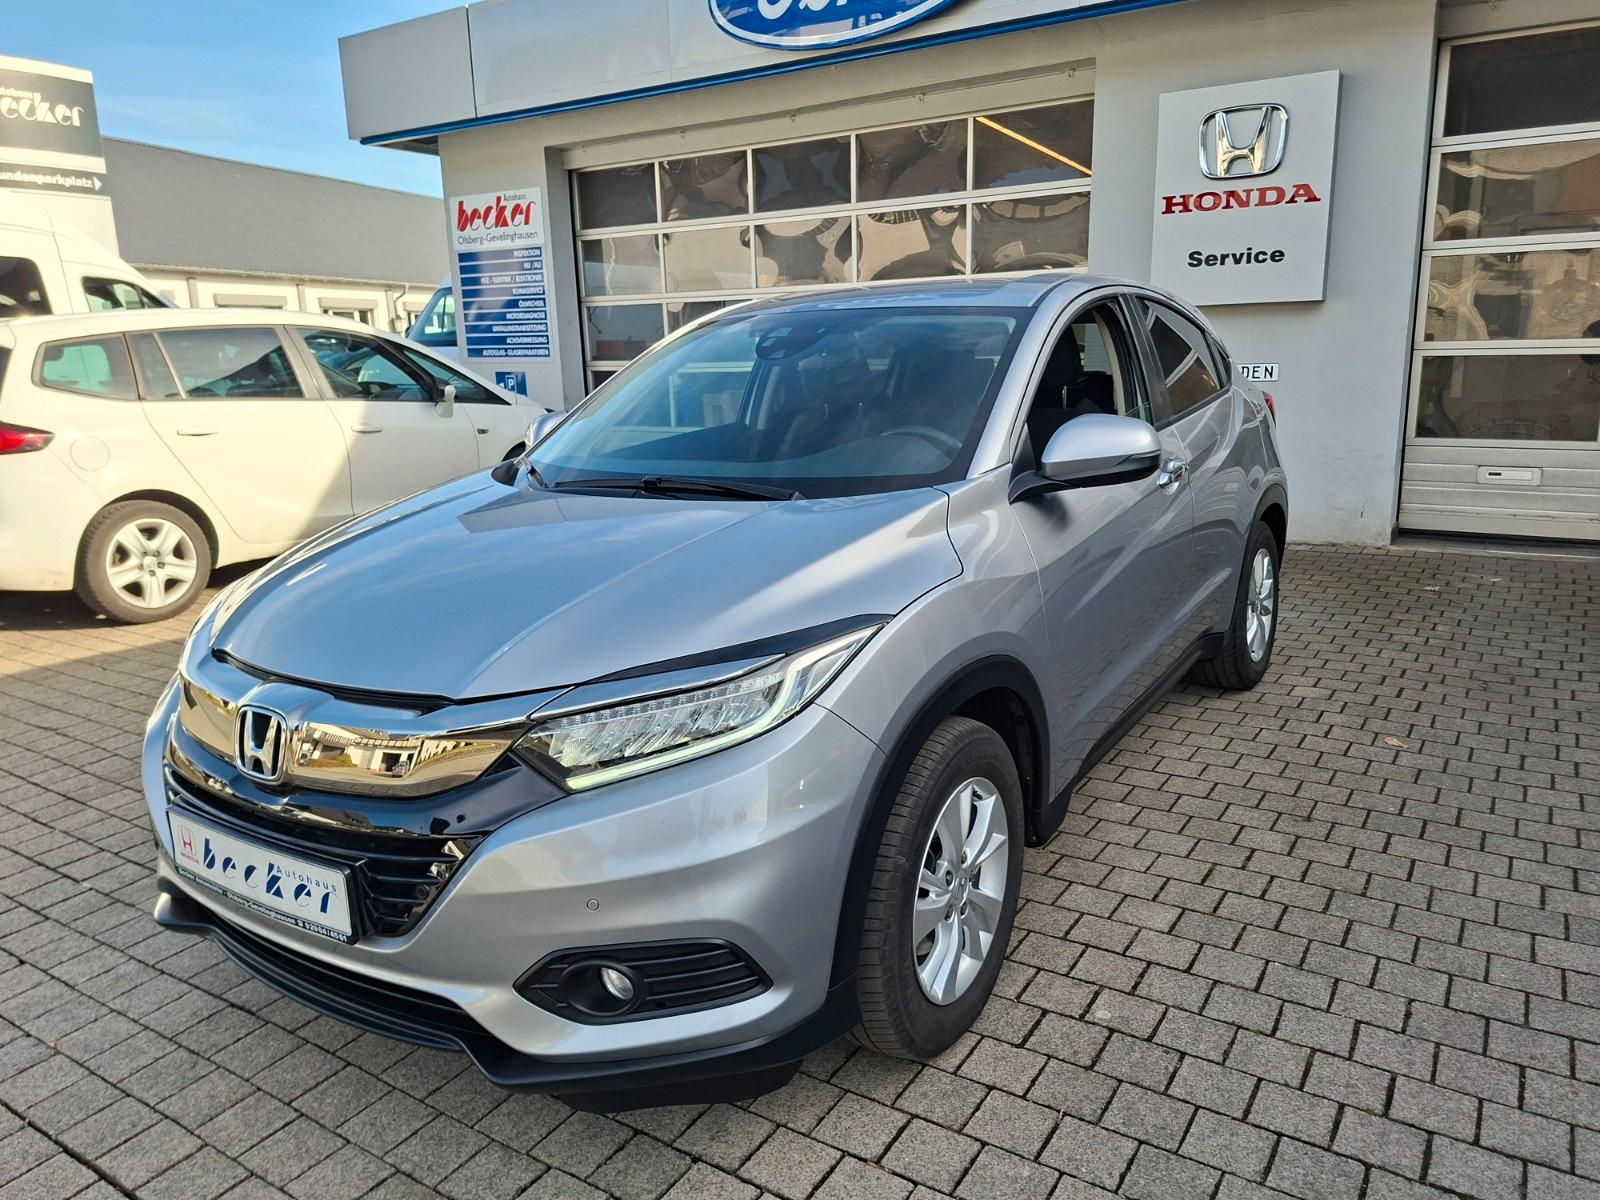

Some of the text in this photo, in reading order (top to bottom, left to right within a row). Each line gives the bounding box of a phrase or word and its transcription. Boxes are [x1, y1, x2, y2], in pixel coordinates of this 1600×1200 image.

[1161, 183, 1321, 215] HONDA
[457, 196, 536, 233] becker
[513, 249, 541, 257] INSPEKTION
[1187, 247, 1285, 268] Service
[512, 287, 544, 295] KLIMASERVICE
[506, 312, 546, 320] MOTORDIAGNOSE
[506, 336, 548, 344] ACHSVERMESSUNG
[508, 379, 515, 390] P
[203, 837, 338, 914] becker
[276, 866, 337, 892] Autohaus
